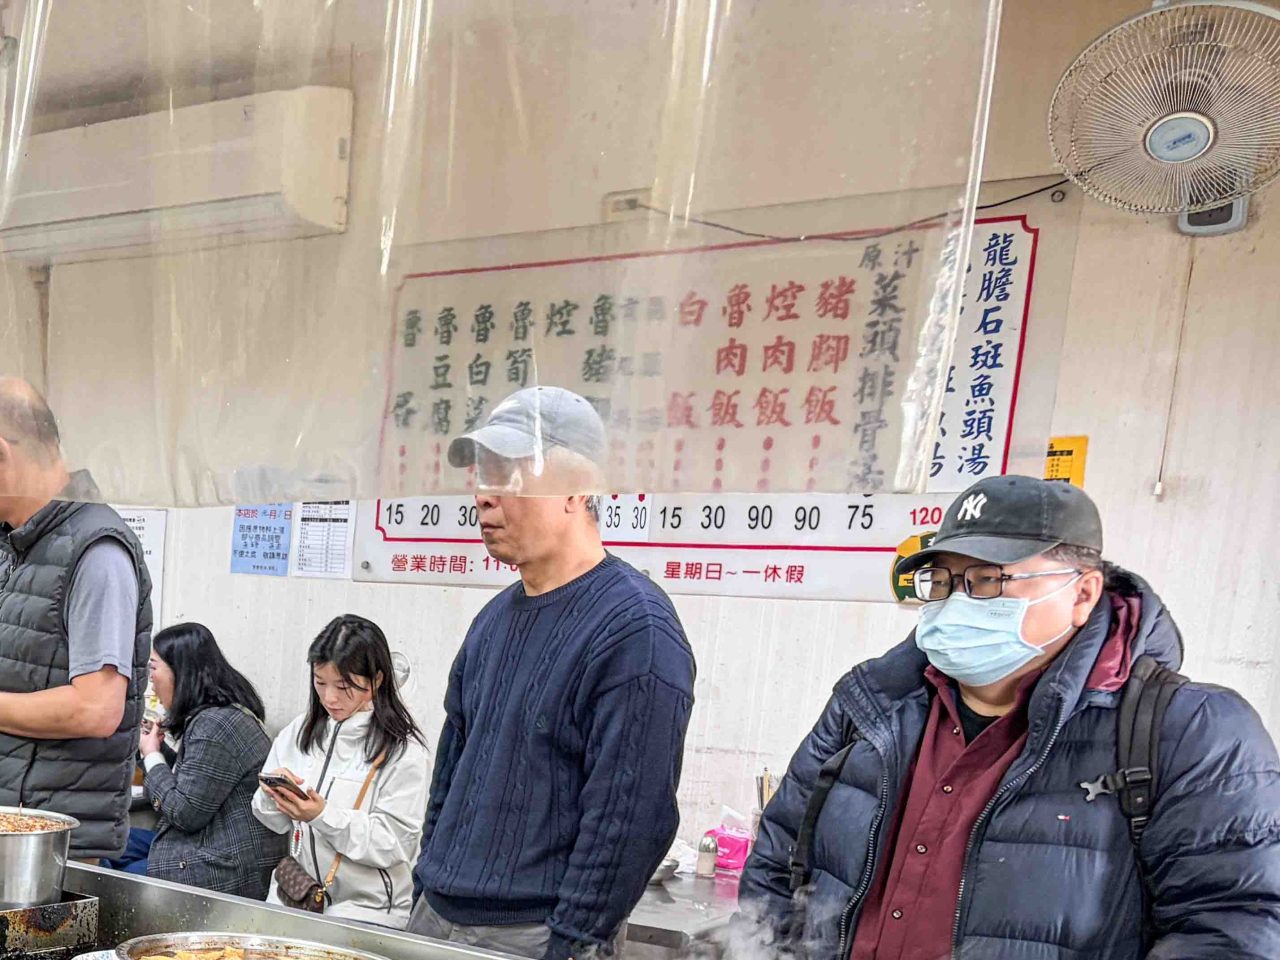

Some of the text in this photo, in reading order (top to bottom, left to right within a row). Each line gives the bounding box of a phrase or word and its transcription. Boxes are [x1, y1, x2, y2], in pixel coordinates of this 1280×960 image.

[707, 284, 752, 428] 魯肉飯
[803, 276, 857, 426] 豬腳飯
[957, 233, 1018, 476] 龍膽石斑魚頭湯
[386, 504, 942, 531] 15 20 30 35 30 15 30 90 90 75 120
[957, 493, 987, 520] NY
[391, 554, 475, 574] 營業時間:
